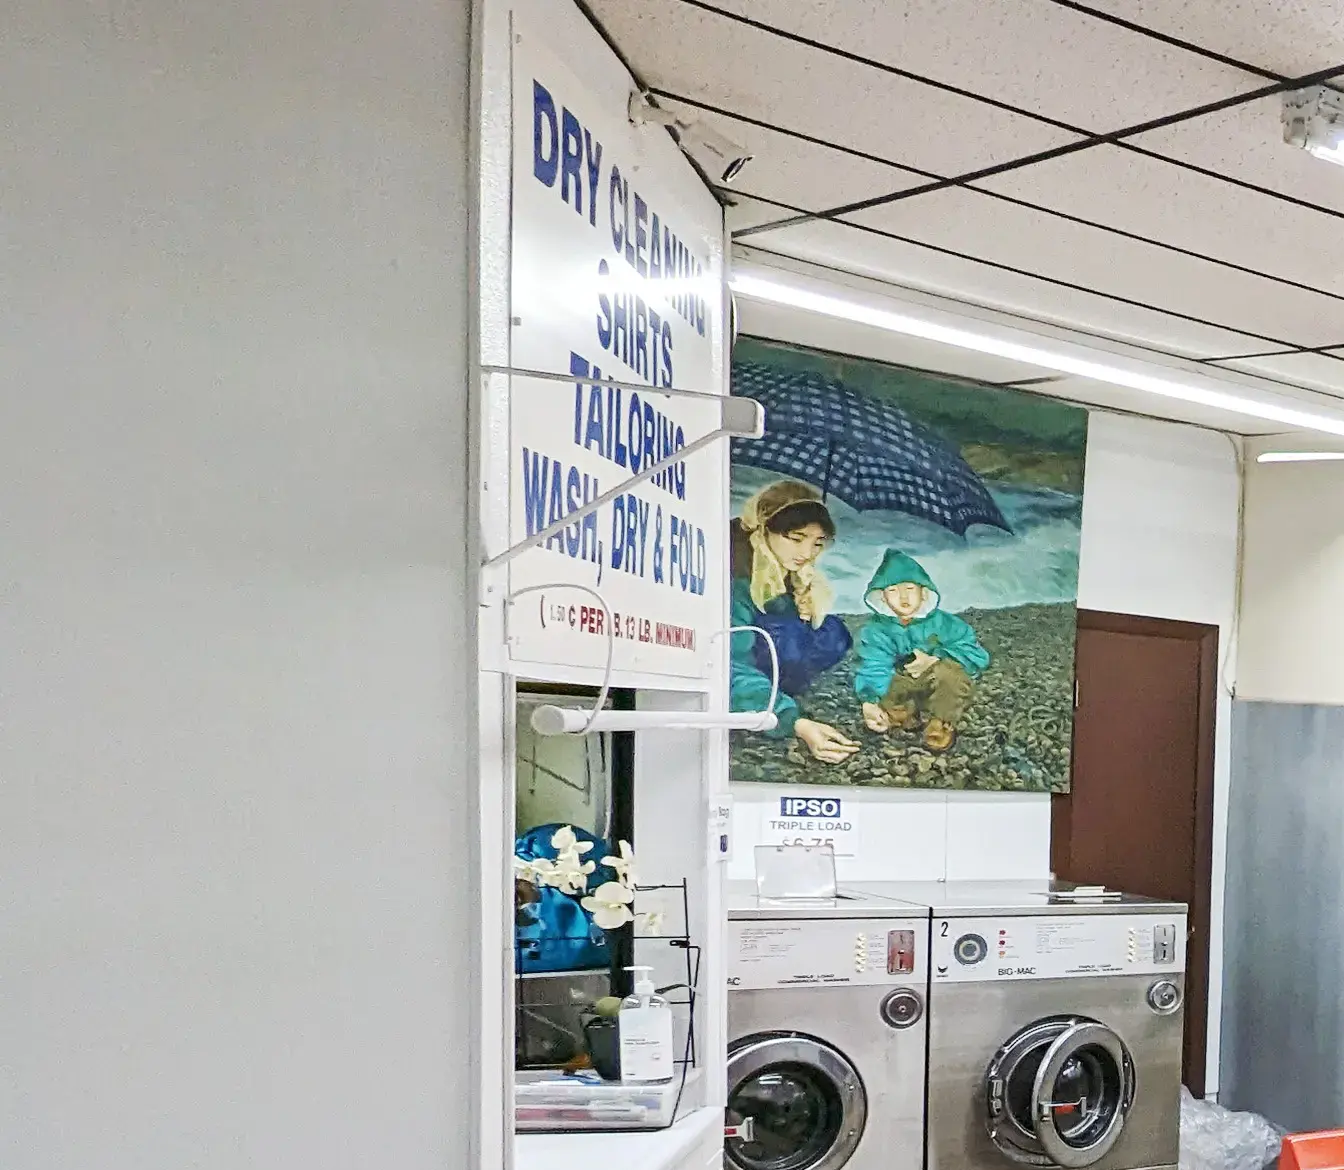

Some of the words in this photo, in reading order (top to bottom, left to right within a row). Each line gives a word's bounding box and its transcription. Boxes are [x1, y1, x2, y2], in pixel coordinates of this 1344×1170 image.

[533, 78, 603, 228] DRY
[609, 163, 706, 338] CLEANING
[596, 258, 673, 398] SHIRTS
[569, 350, 686, 501] TAILORING
[522, 447, 603, 587] WASH,
[611, 493, 650, 578] DRY
[653, 503, 664, 584] &
[670, 514, 706, 596] FOLD
[580, 605, 605, 635] PER
[607, 612, 624, 639] B.
[625, 615, 636, 640] 13
[785, 799, 839, 817] IPSO
[769, 820, 814, 831] TRIPLE
[817, 821, 852, 832] LOAD
[940, 921, 949, 938] 2
[997, 966, 1037, 976] BIG-MAC
